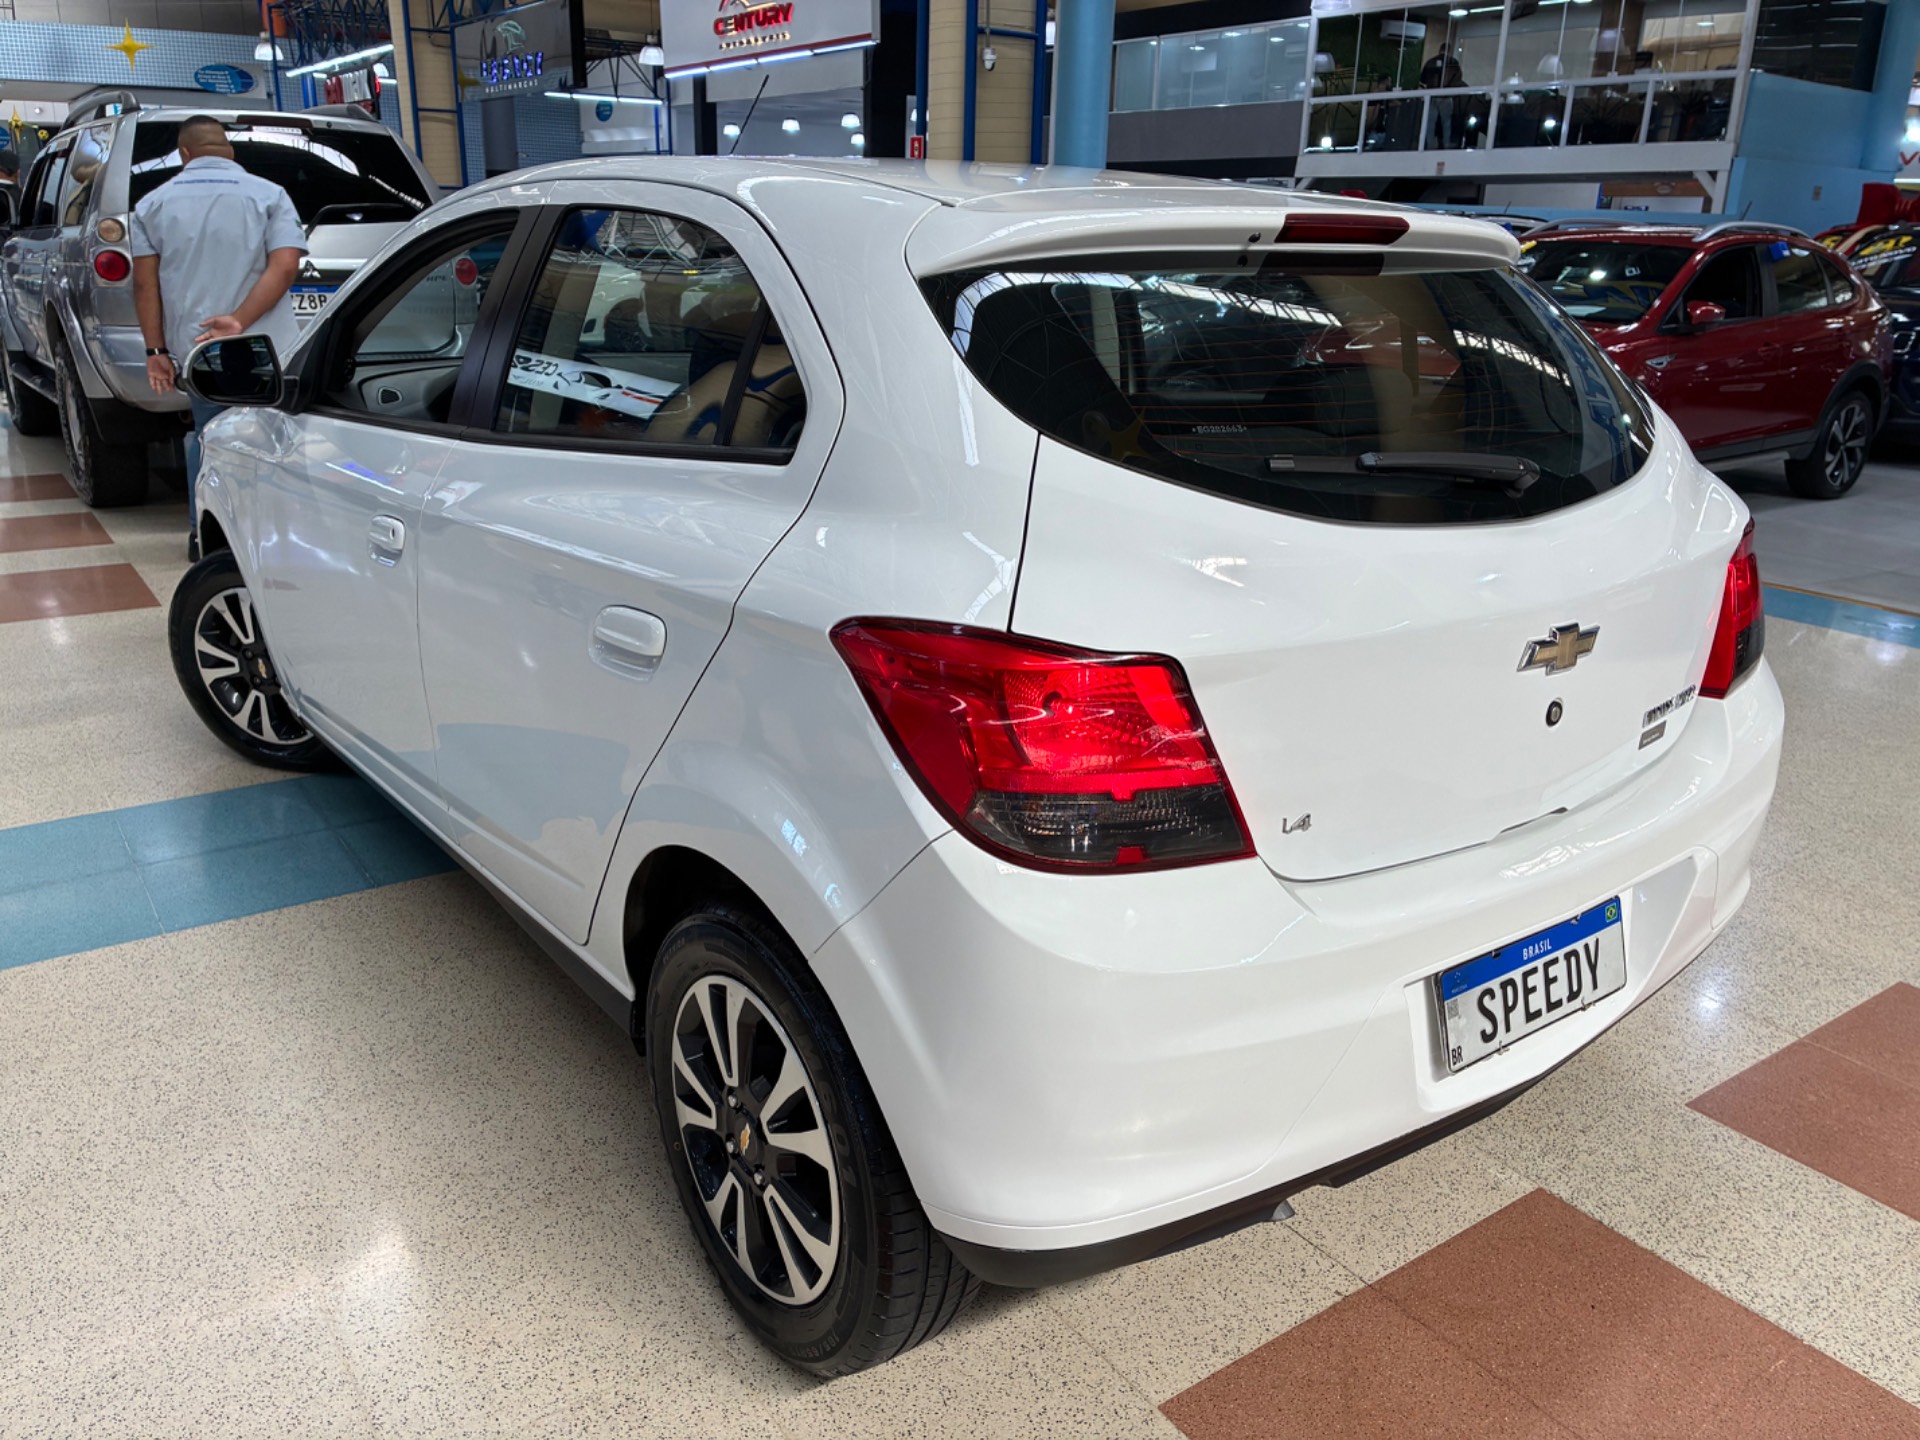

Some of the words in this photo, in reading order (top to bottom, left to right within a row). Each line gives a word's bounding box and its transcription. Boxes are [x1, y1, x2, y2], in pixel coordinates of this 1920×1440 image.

[713, 2, 795, 36] CENTURY
[1522, 937, 1553, 961] BRASIL
[1477, 936, 1600, 1044] SPEEDY
[1451, 1045, 1464, 1066] BR
